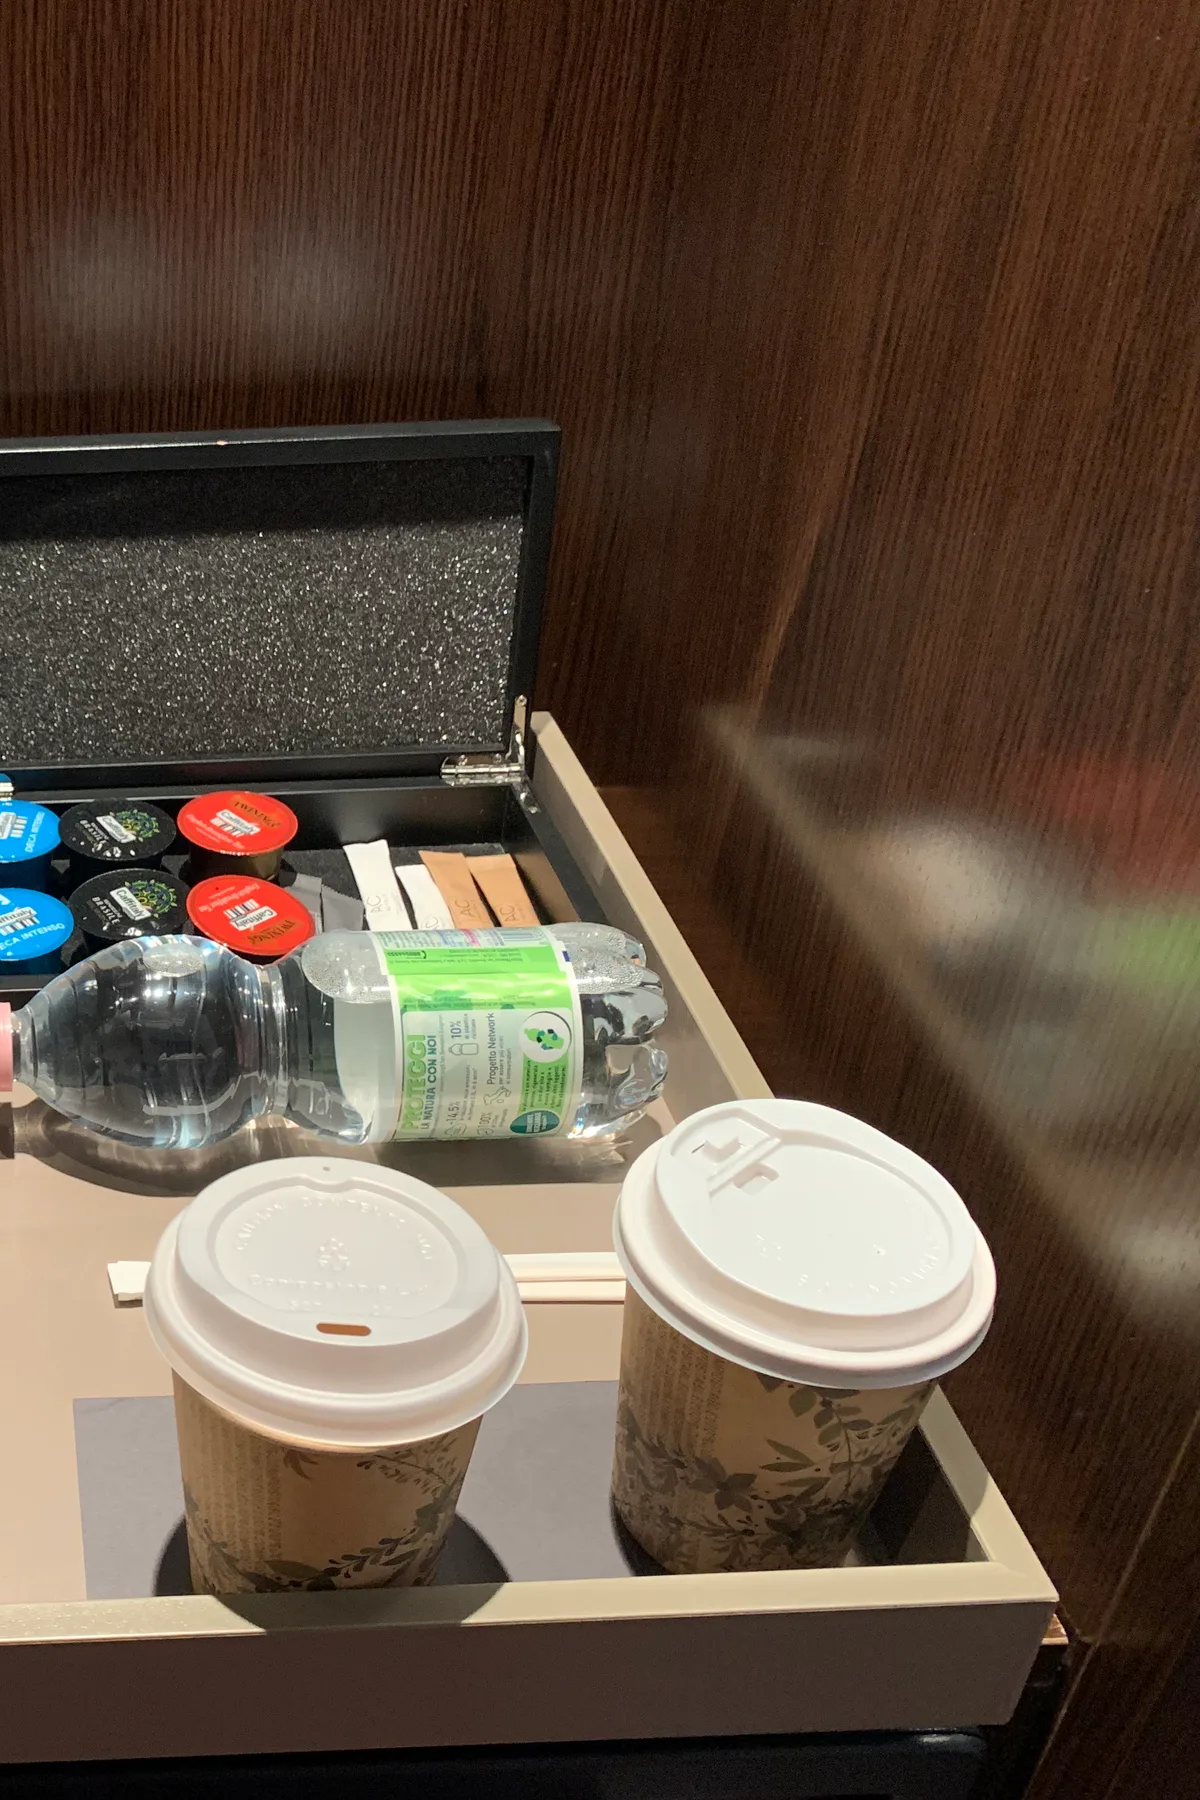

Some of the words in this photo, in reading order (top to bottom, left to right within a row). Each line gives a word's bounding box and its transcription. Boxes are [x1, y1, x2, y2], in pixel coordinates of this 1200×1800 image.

[92, 896, 121, 925] BRASILE
[115, 889, 146, 918] Caffitaly
[455, 899, 475, 918] AC
[500, 904, 517, 922] AC
[235, 908, 274, 928] Caffitaly
[20, 923, 66, 940] INTENSO
[450, 1021, 462, 1040] 10%
[486, 1012, 497, 1049] Network
[427, 1035, 437, 1056] NOI
[427, 1059, 437, 1084] CON
[487, 1050, 499, 1085] Progetto
[401, 1034, 427, 1131] PROTEGGI
[423, 1086, 437, 1121] NATURA
[420, 1122, 430, 1130] LA
